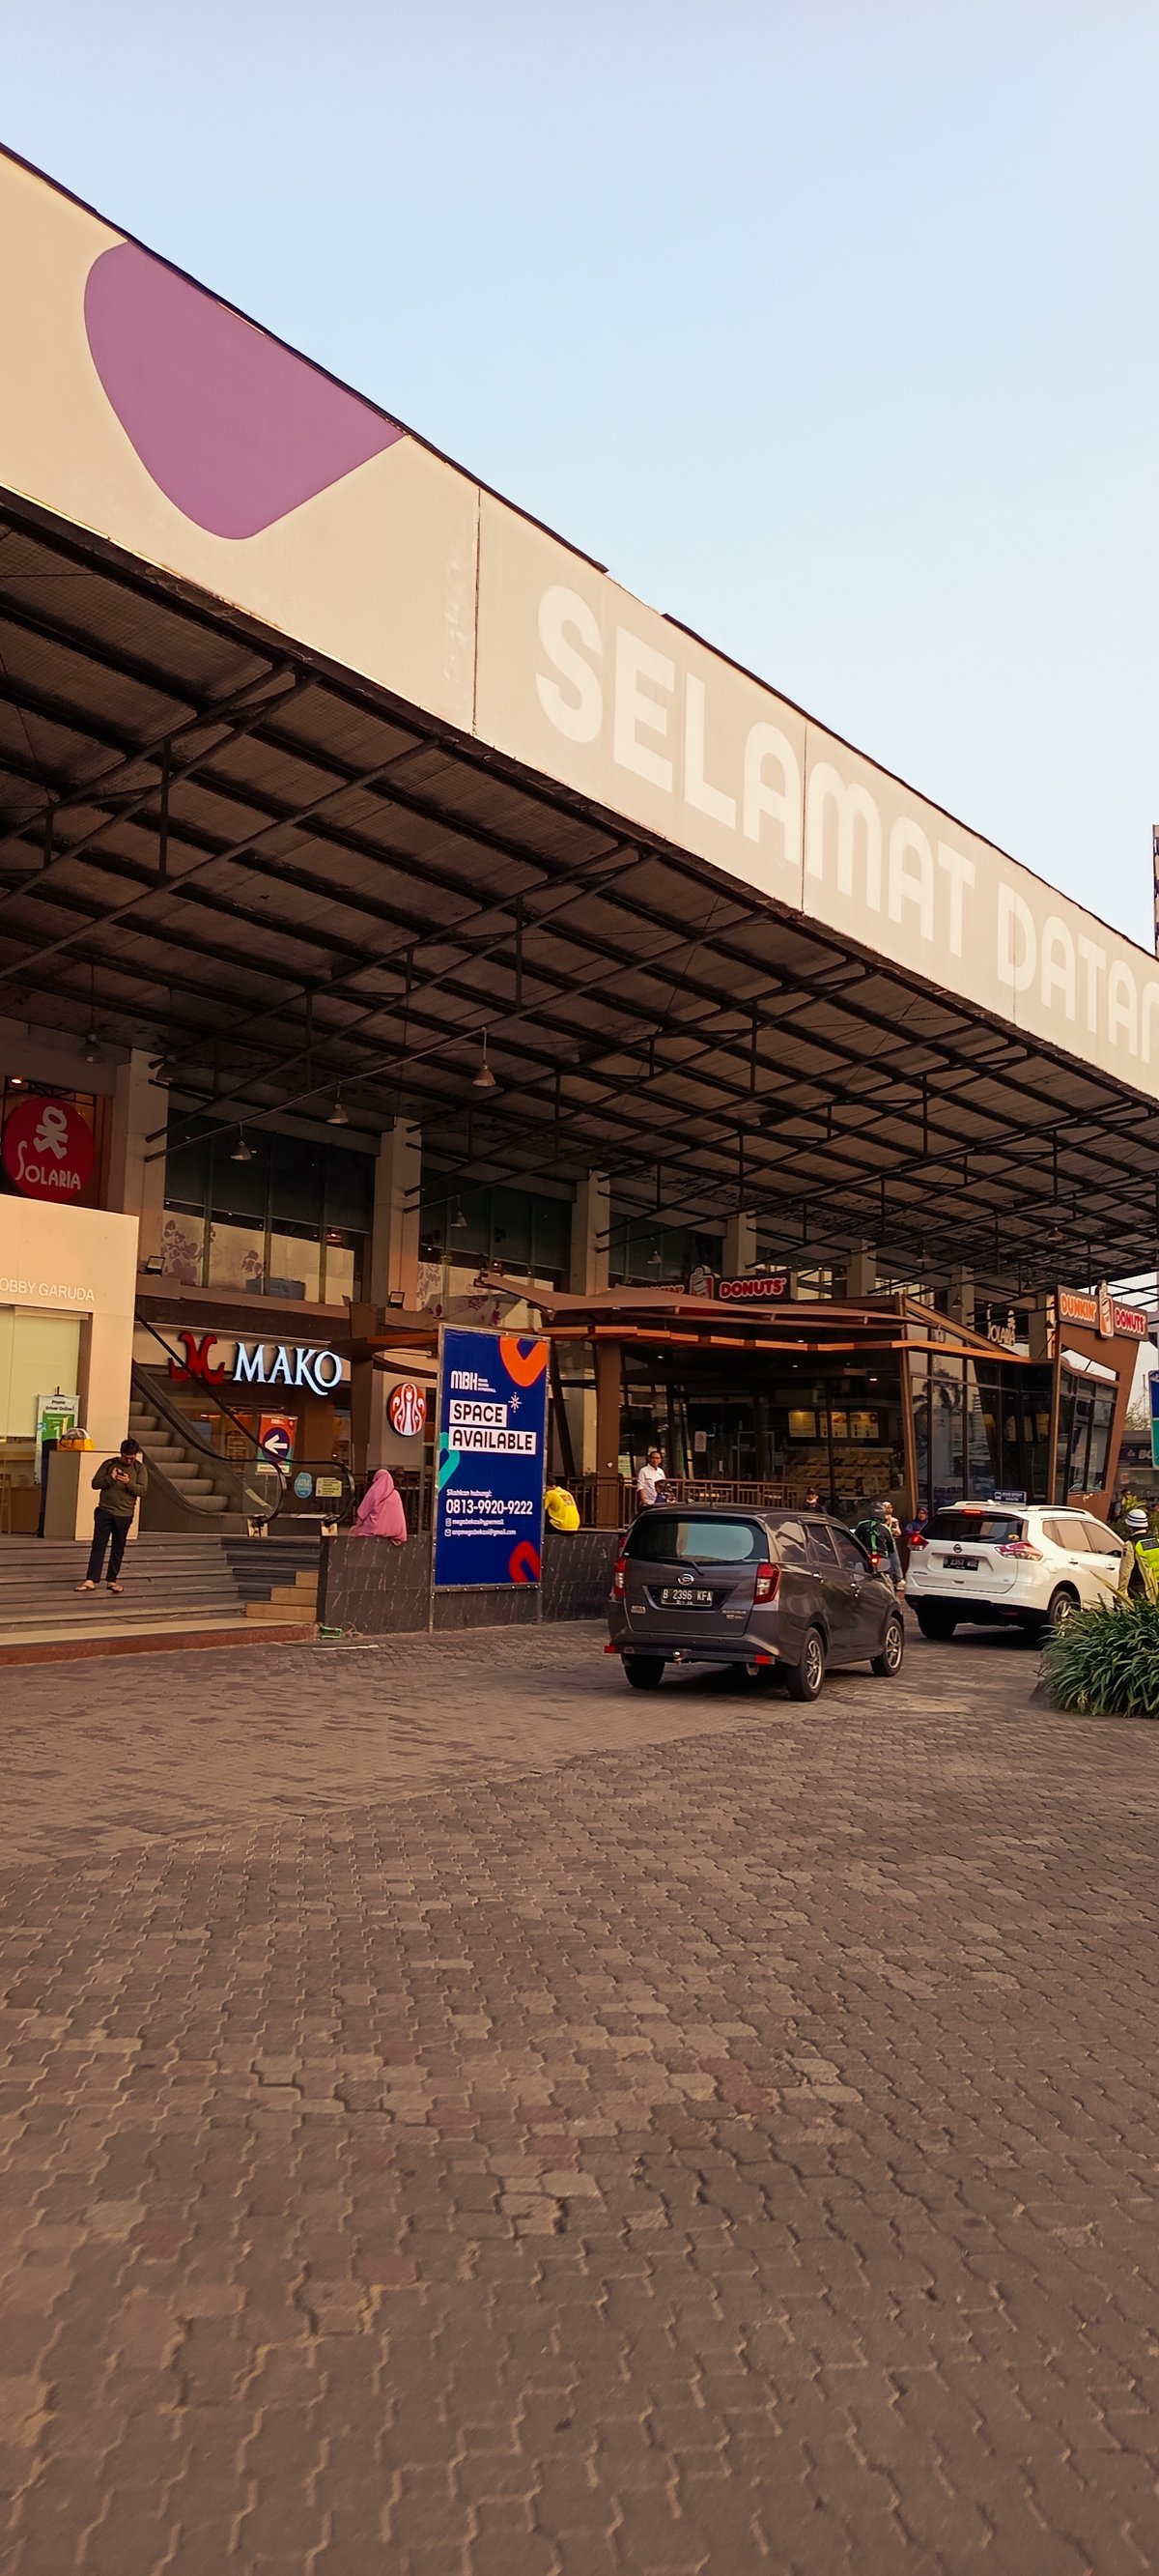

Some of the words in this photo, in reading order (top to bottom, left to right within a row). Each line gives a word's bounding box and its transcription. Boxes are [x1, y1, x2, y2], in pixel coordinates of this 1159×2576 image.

[535, 585, 975, 959] SELAMAT
[14, 1140, 81, 1190] SOLARIA
[39, 1282, 95, 1302] GARUDA
[720, 1277, 785, 1299] DONUTS
[1115, 1306, 1146, 1335] DONUTS
[232, 1342, 343, 1396] MAKO
[450, 1370, 478, 1391] MBH
[453, 1402, 503, 1423] SPACE
[452, 1429, 533, 1451] AVAILABLE
[445, 1499, 533, 1515] 0813-9920-9222
[663, 1589, 668, 1599] B
[672, 1589, 693, 1600] 2396
[696, 1590, 712, 1601] KFA
